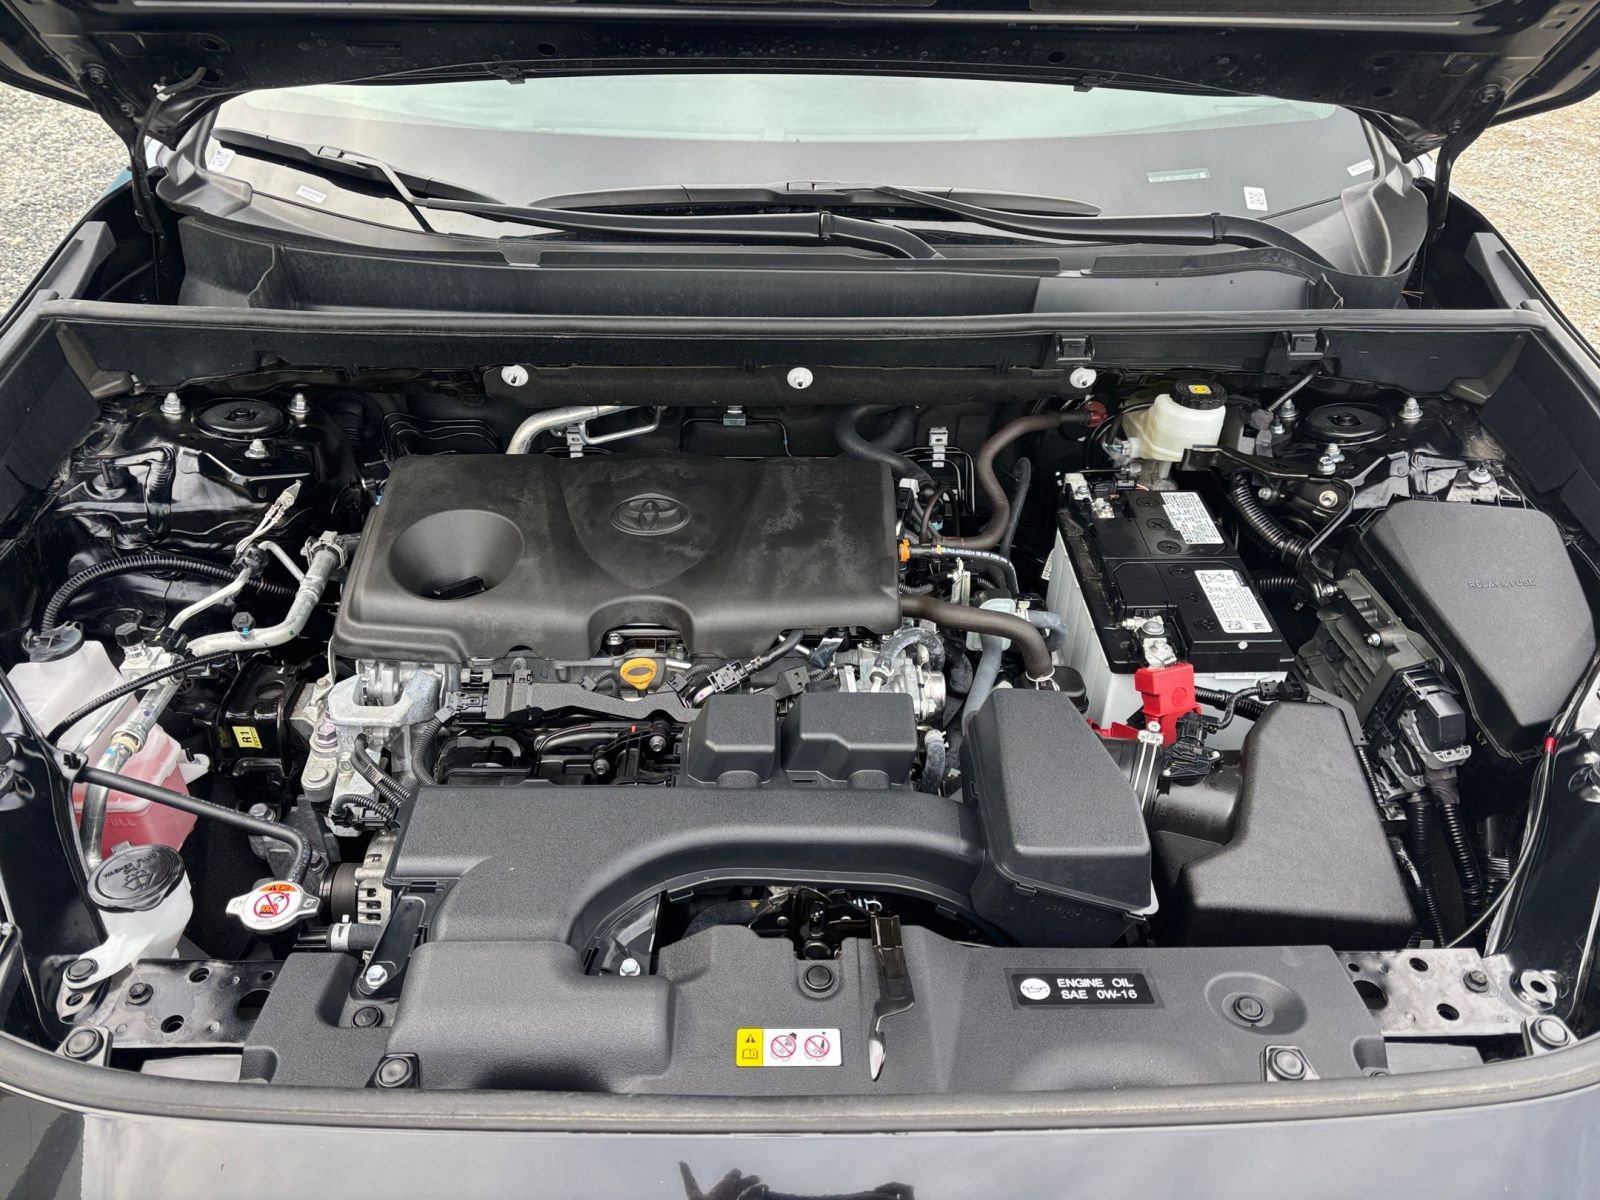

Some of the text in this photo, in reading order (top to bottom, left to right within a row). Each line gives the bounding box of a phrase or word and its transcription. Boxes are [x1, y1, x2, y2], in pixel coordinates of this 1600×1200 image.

[1509, 578, 1536, 587] FUSE
[239, 731, 252, 743] R1
[103, 862, 134, 878] WASHER
[1056, 978, 1134, 988] ENGINE OIL
[1061, 990, 1137, 999] SAE 0W-16
